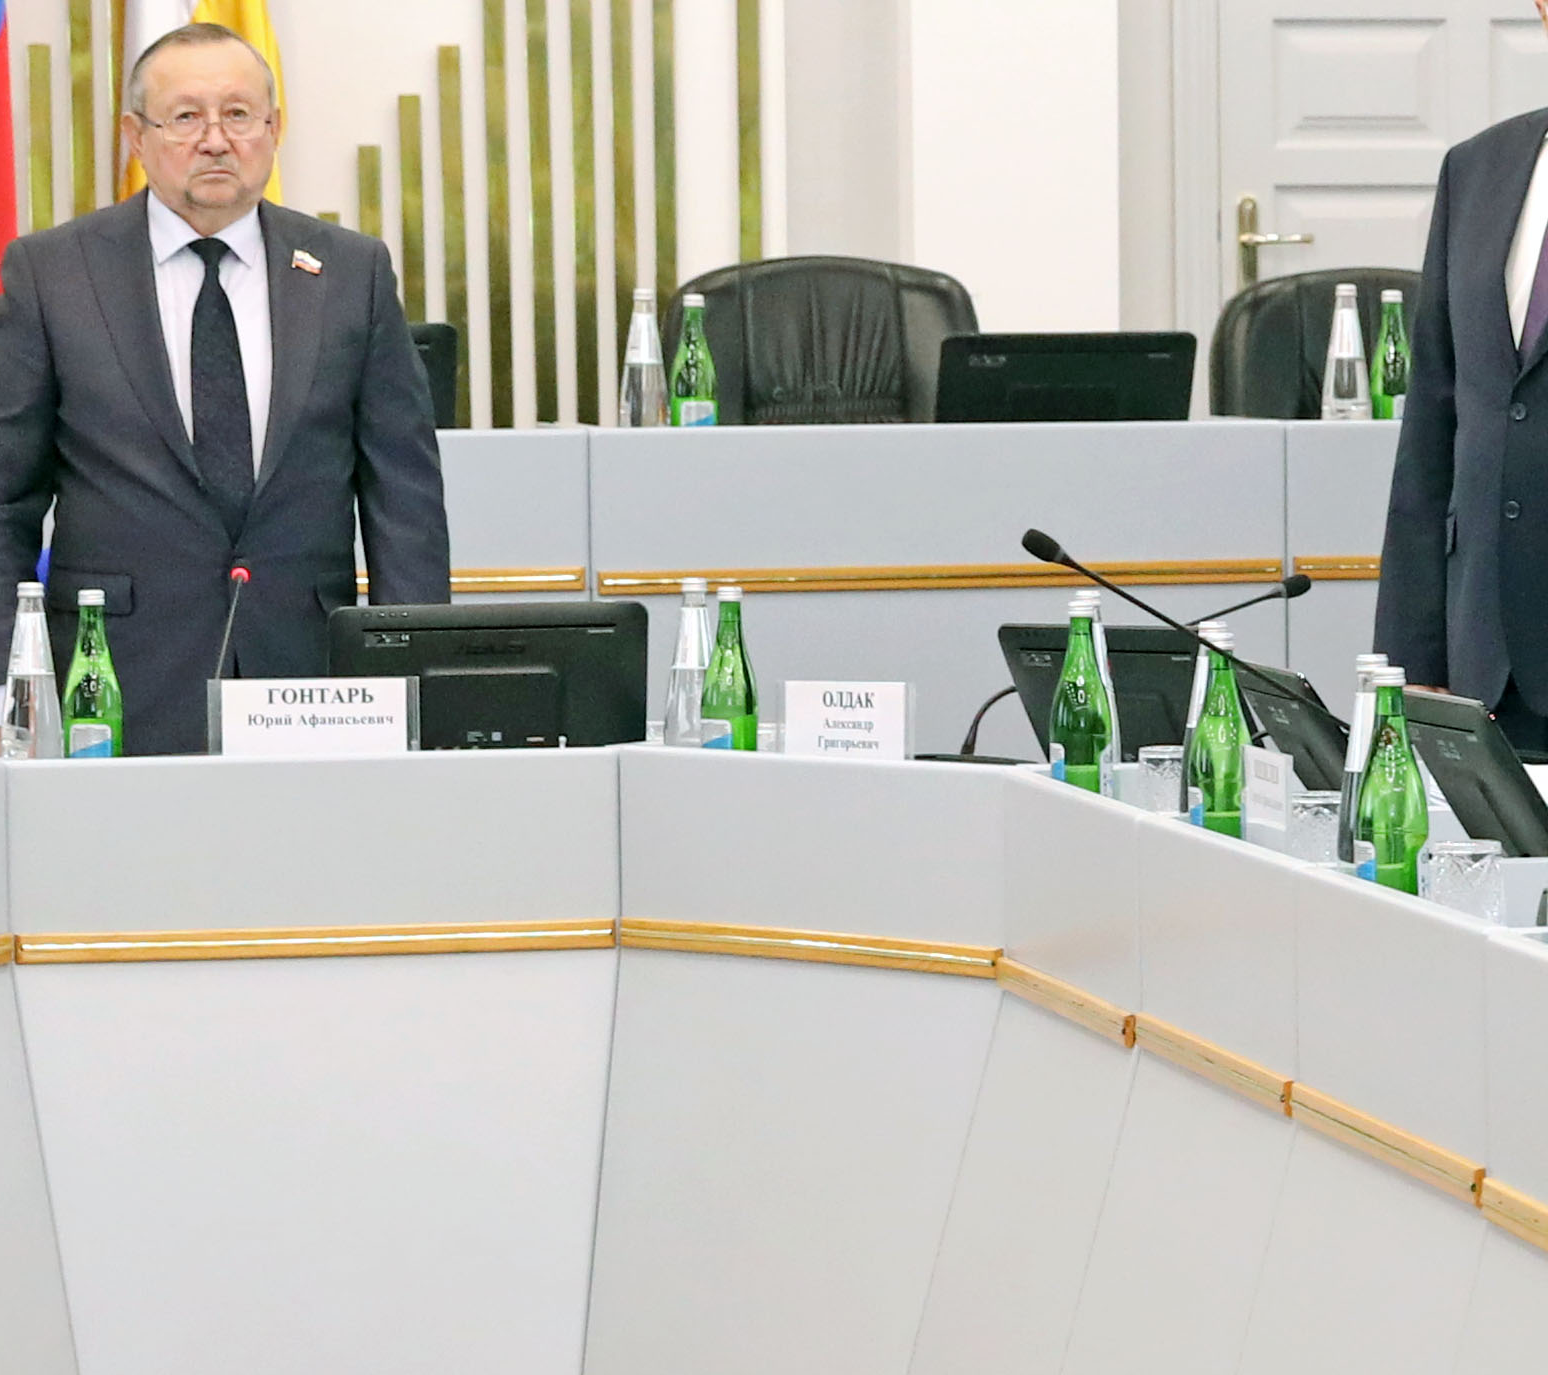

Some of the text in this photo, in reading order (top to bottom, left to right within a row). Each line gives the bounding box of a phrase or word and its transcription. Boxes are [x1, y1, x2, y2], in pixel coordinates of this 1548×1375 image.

[267, 687, 374, 705] ГОНТАРЬ
[822, 690, 875, 709] ОЛДАК
[248, 713, 394, 728] Юрий Афанасьевич
